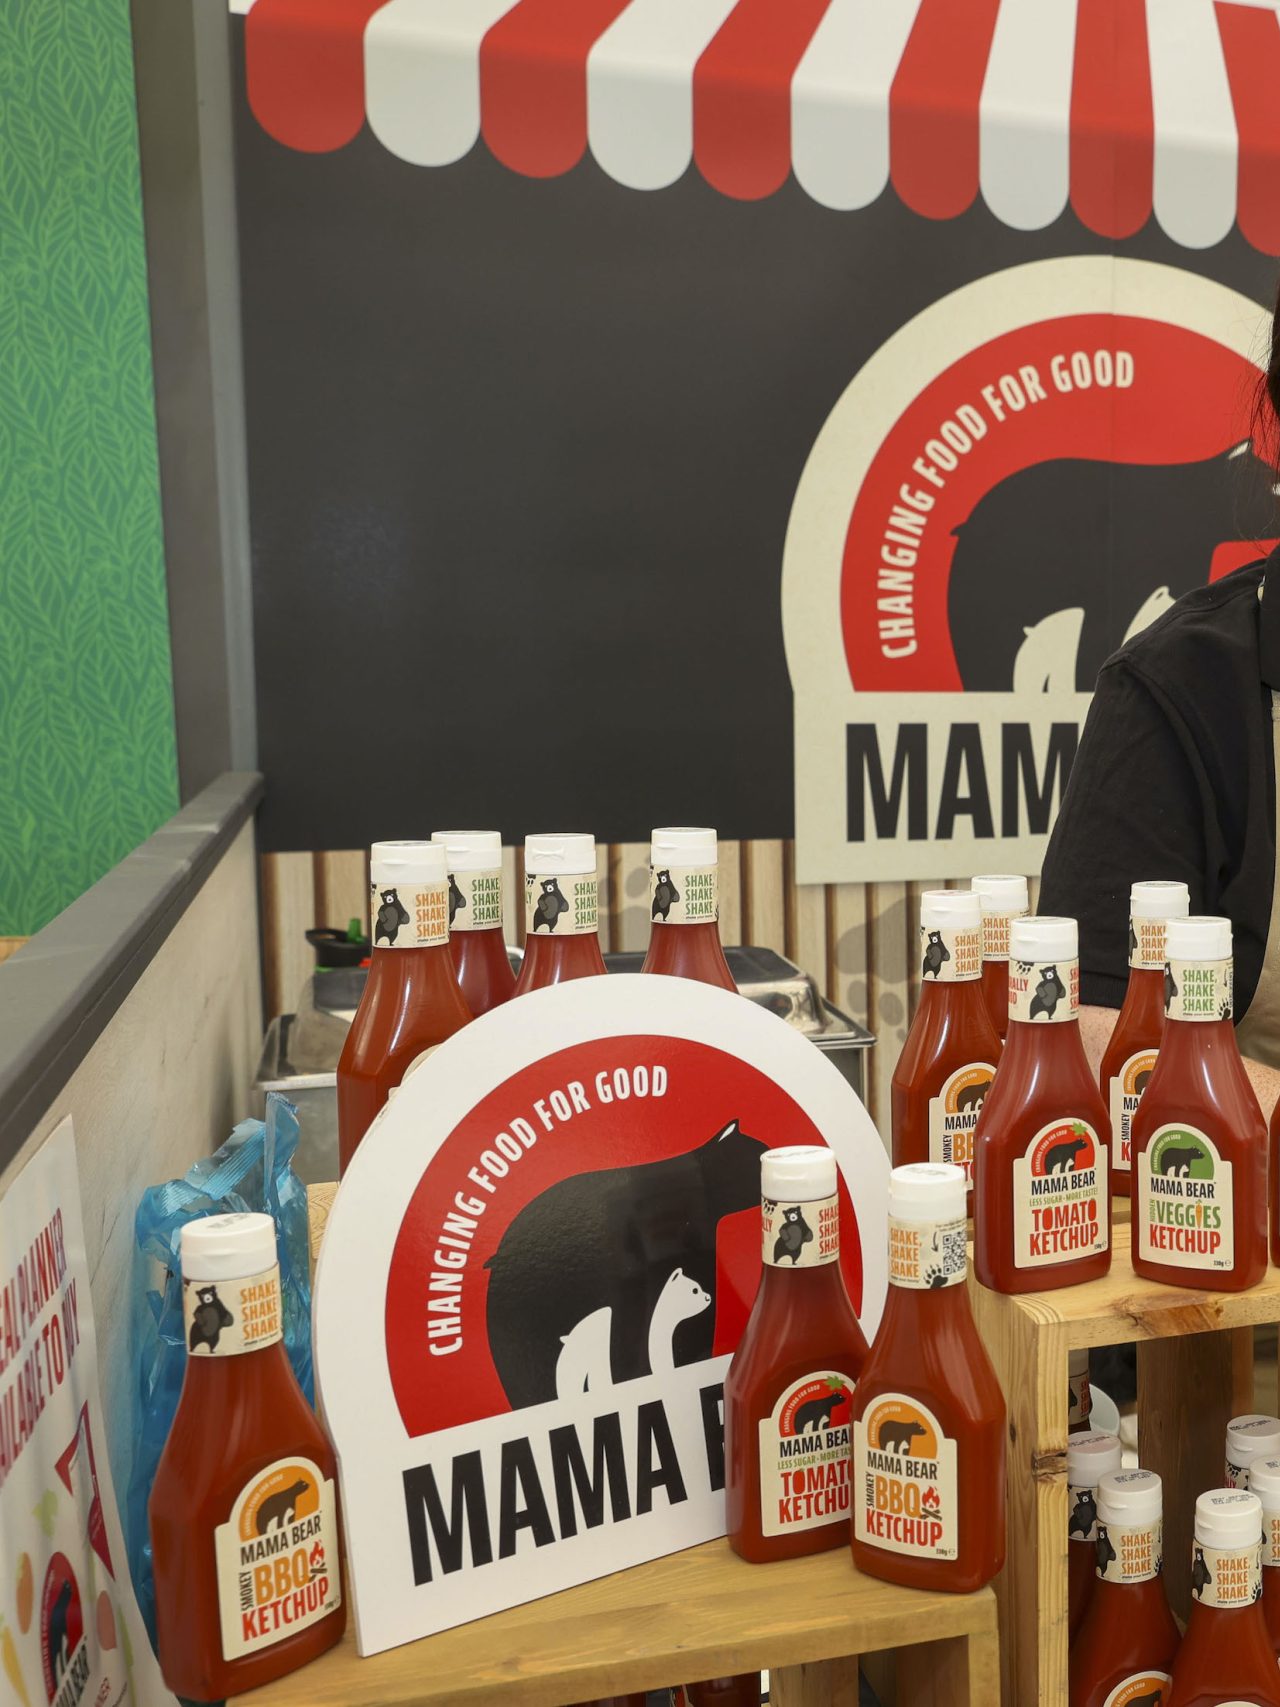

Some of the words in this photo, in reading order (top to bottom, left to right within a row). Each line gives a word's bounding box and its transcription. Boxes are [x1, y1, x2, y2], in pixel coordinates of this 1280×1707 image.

[877, 483, 935, 659] CHANGING
[913, 403, 988, 488] FOOD
[981, 365, 1047, 422] FOR
[1050, 349, 1135, 395] GOOD
[472, 892, 500, 906] SHAKE
[685, 888, 713, 902] SHAKE
[416, 906, 446, 922] SHAKE
[473, 905, 500, 920] SHAKE
[685, 901, 713, 916] SHAKE
[416, 921, 446, 937] SHAKE
[983, 930, 1009, 941] SHAKE
[955, 946, 980, 960] SHAKE
[983, 942, 1010, 953] SHAKE
[955, 959, 980, 973] SHAKE
[1183, 970, 1217, 983] SHAKE,
[1183, 984, 1214, 997] SHAKE
[1183, 999, 1214, 1011] SHAKE
[1122, 1113, 1130, 1141] SMOKEY
[943, 1134, 952, 1163] SMOKEY
[1031, 1177, 1068, 1195] MAMA
[1071, 1170, 1095, 1190] BEAR
[1150, 1177, 1182, 1197] MAMA
[1186, 1182, 1215, 1199] BEAR
[1029, 1198, 1044, 1207] LESS
[1044, 1195, 1062, 1205] SUGAR
[1066, 1190, 1082, 1201] MORE
[427, 1190, 486, 1357] CHANGING
[468, 1117, 537, 1195] FOOD
[533, 1080, 591, 1132] FOR
[595, 1065, 669, 1105] GOOD
[1032, 1199, 1097, 1232] TOMATO
[1029, 1222, 1099, 1257] KETCHUP
[1149, 1223, 1221, 1254] KETCHUP
[890, 1244, 919, 1262] SHAKE
[890, 1260, 919, 1278] SHAKE
[242, 1297, 277, 1323] SHAKE
[43, 1314, 64, 1396] TO
[61, 1277, 80, 1369] BUY
[243, 1314, 279, 1340] SHAKE
[780, 1434, 823, 1458] MAMA
[826, 1427, 850, 1452] BEA
[777, 1460, 793, 1471] LESS
[793, 1455, 816, 1468] SUGAR
[820, 1450, 839, 1462] MORE
[867, 1451, 902, 1476] MAMA
[905, 1459, 938, 1480] BEAR
[402, 1397, 689, 1588] MAMA
[866, 1471, 875, 1508] SMOKEY
[875, 1474, 922, 1519] BBQ
[866, 1508, 943, 1548] KETCHUP
[240, 1532, 289, 1566] MAMA
[292, 1514, 322, 1546] BEAR
[1121, 1545, 1152, 1561] SHAKE
[254, 1547, 311, 1606] BBQ
[1121, 1559, 1152, 1575] SHAKE
[1216, 1570, 1249, 1585] SHAKE
[239, 1570, 253, 1611] SMOKEY
[1216, 1584, 1249, 1599] SHAKE
[242, 1576, 329, 1642] KETCHUP
